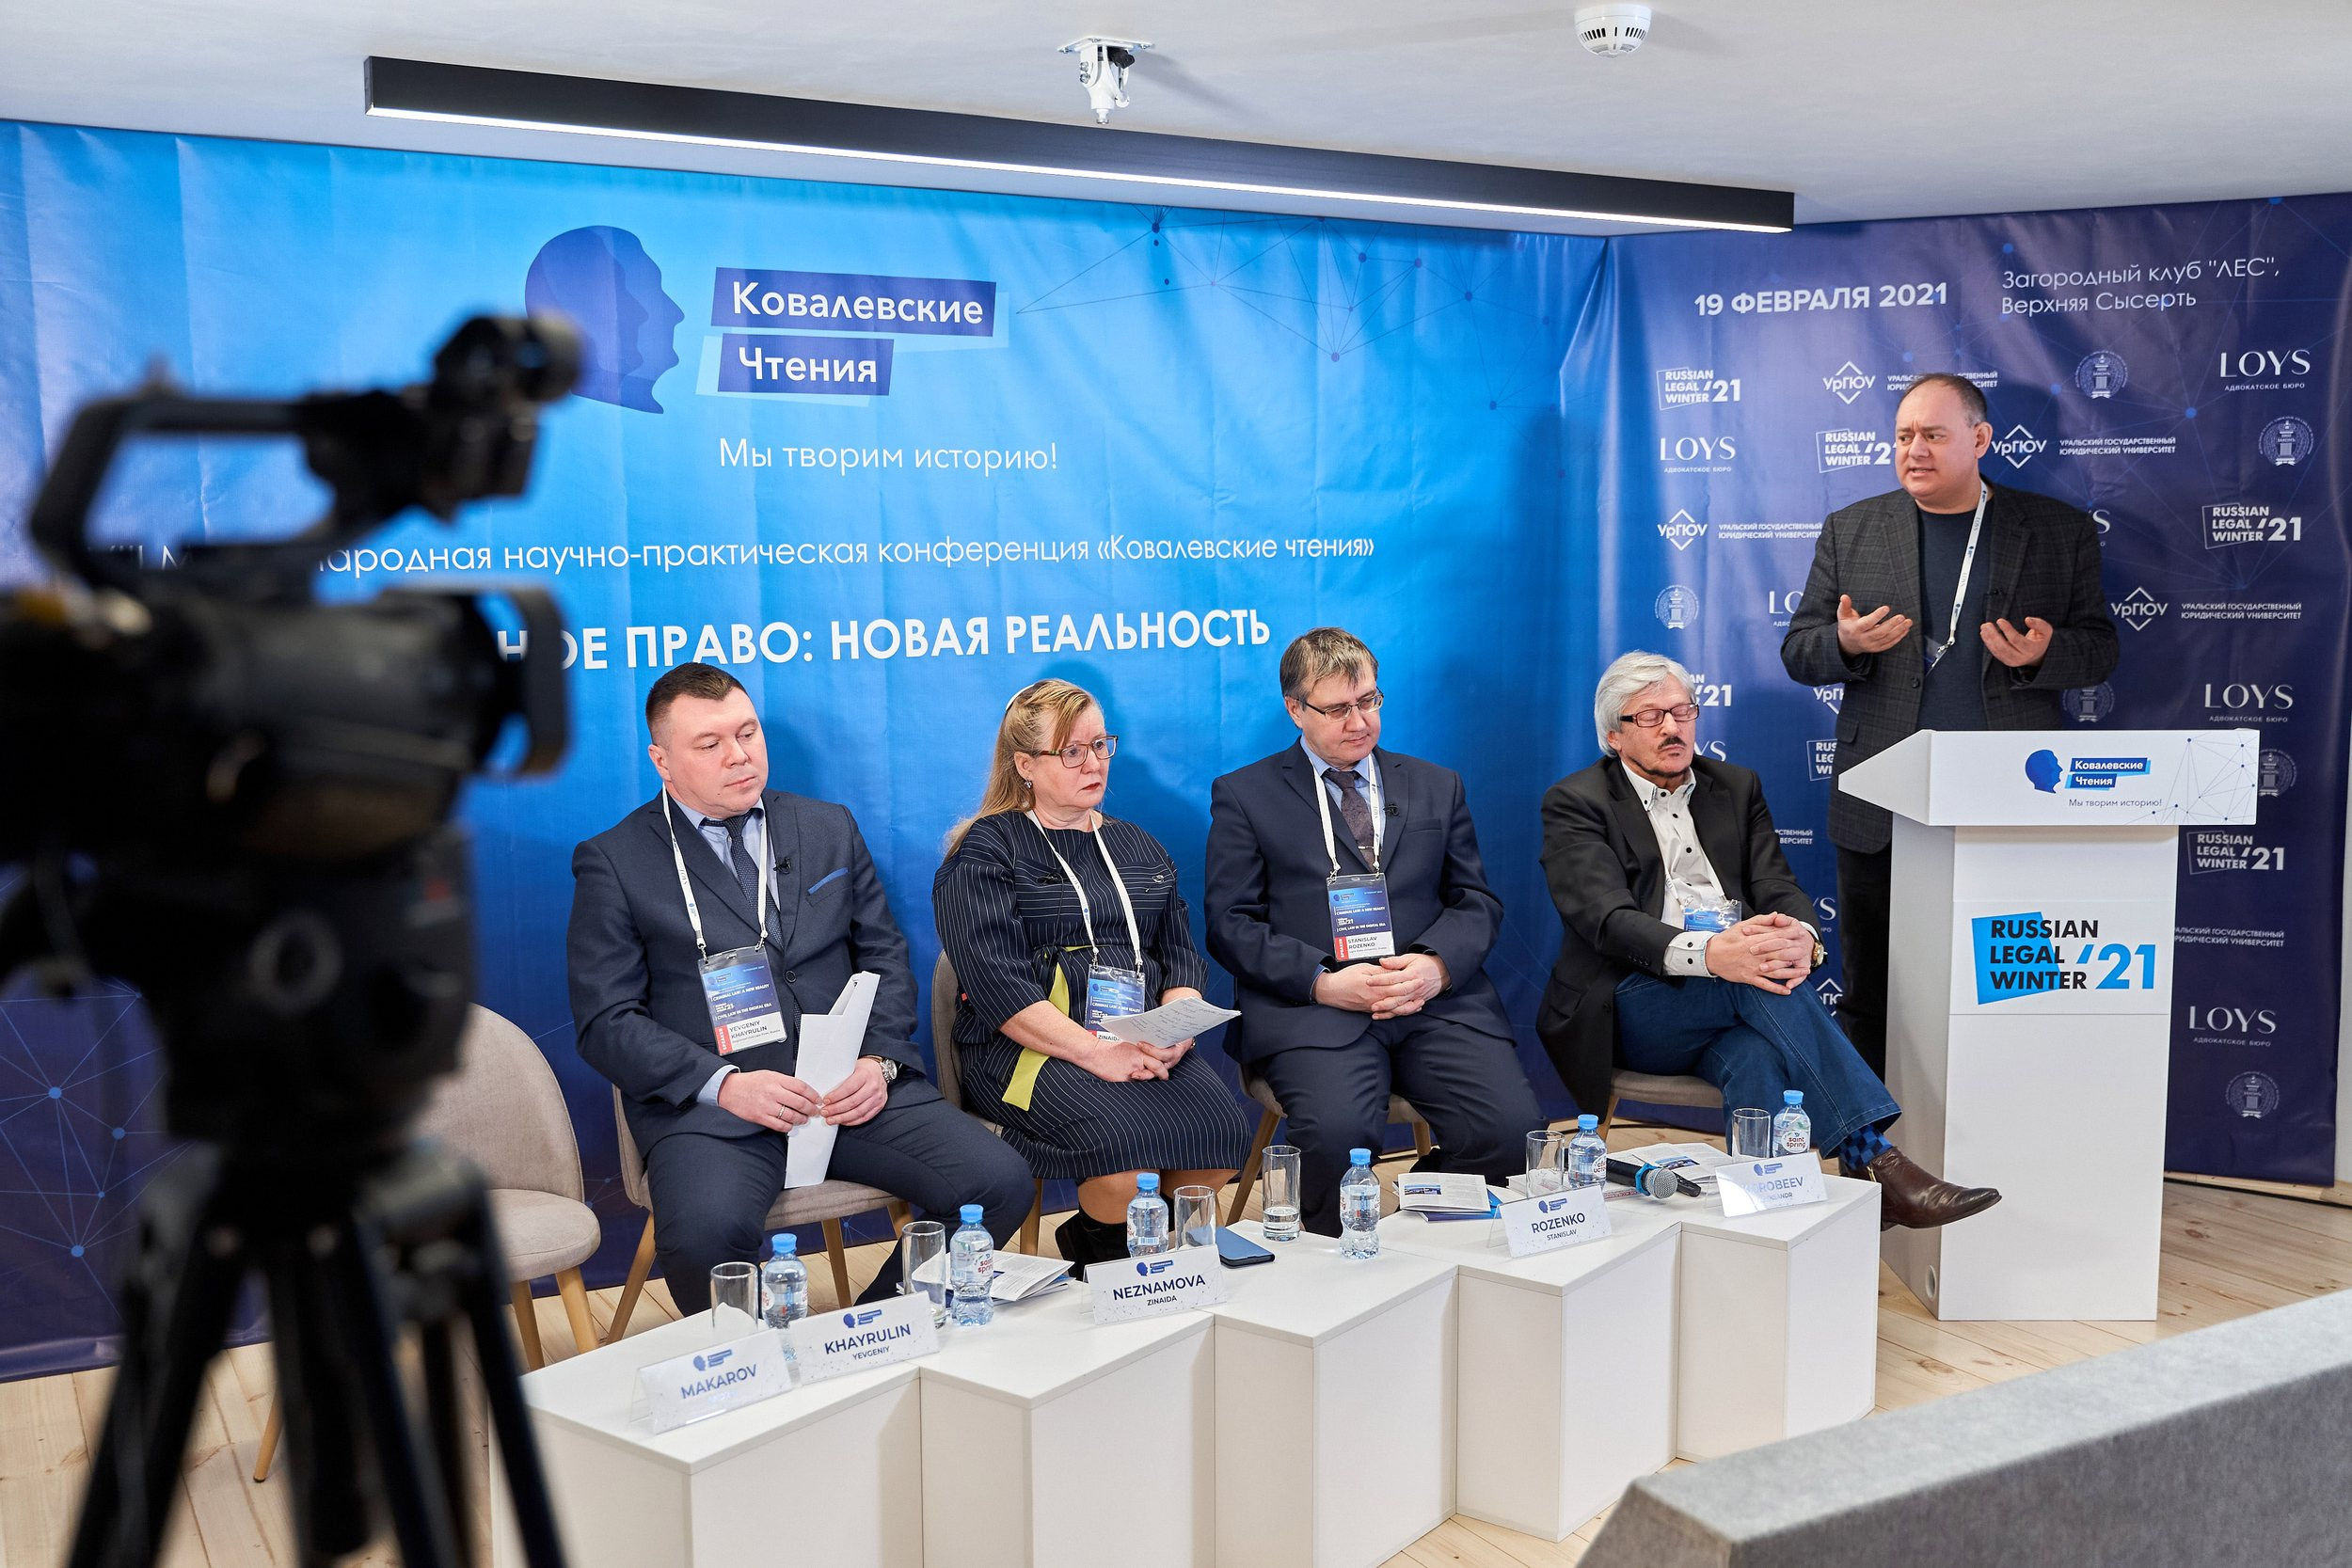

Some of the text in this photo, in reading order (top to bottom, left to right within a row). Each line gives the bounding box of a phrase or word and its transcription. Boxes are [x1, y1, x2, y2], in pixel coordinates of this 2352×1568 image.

[2003, 257, 2280, 291] Загородный клуб "ЛЕС",
[732, 280, 984, 325] Ковалевские
[1694, 282, 1947, 316] 19 ФЕВРАЛЯ 2021
[2002, 293, 2197, 317] Верхняя Сысерть
[739, 346, 877, 383] Чтения
[2220, 349, 2311, 377] LOYS
[1665, 370, 1713, 380] RUSSIAN
[1665, 381, 1699, 391] LEGAL
[1665, 392, 1709, 403] WINTER
[1825, 431, 1875, 443] RUSSIAN
[2059, 436, 2176, 447] УРАЛЬСКИЙ ГОСУДАРСТВЕННЫЙ
[1660, 436, 1736, 462] LOYS
[1825, 443, 1860, 454] LEGAL
[2059, 445, 2175, 455] ЮРИДИЧЕСКИЙ УНИВЕРСИТЕТ
[720, 437, 1057, 477] Мы творим историю!
[1825, 454, 1870, 466] WINTER
[2213, 506, 2269, 516] RUSSIAN
[2213, 519, 2251, 530] LEGAL
[1719, 531, 1772, 539] ЮРИДИЧЕСКИЙ
[2213, 531, 2264, 542] WINTER
[161, 543, 491, 578] Мародная
[503, 537, 868, 576] научно-практическая
[879, 535, 1089, 567] конференция
[1097, 533, 1278, 560] «Ковалевские
[1284, 536, 1375, 558] чтения»
[1769, 591, 1804, 614] LO
[2182, 602, 2301, 610] УРАЛЬСКИЙ ГОСУДАРСТВЕННЫЙ
[2182, 611, 2301, 620] ЮРИДИЧЕСКИЙ УНИВЕРСИТЕТ
[626, 620, 814, 670] ПРАВО:
[832, 615, 990, 660] НОВАЯ
[1006, 609, 1271, 654] РЕАЛЬНОСТЬ
[2204, 684, 2294, 710] LOYS
[2075, 760, 2143, 771] Ковалевские
[2075, 776, 2113, 786] Чтения
[2086, 800, 2118, 809] творим
[2120, 800, 2162, 809] историю!
[2197, 834, 2253, 845] RUSSIAN
[2197, 846, 2235, 857] LEGAL
[2197, 858, 2248, 869] WINTER
[1990, 920, 2099, 939] RUSSIAN
[2212, 928, 2284, 939] ГОСУДАРСТВЕННЫЙ
[2231, 939, 2284, 947] УНИВЕРСИТЕТ
[1990, 945, 2064, 964] LEGAL
[1990, 972, 2087, 990] WINTER
[2189, 1006, 2277, 1034] LOYS
[729, 1021, 760, 1032] YEVGENIY
[731, 1025, 767, 1039] KHAYRULIN
[2193, 1037, 2246, 1046] АДВОКАТСКОЕ
[1532, 1212, 1585, 1233] ROZENKO
[1547, 1229, 1577, 1241] STANISLAV
[1113, 1275, 1205, 1300] NEZNAMOVA
[1147, 1295, 1177, 1306] ZINAIDA
[825, 1323, 911, 1354] KHAYRULIN
[852, 1346, 890, 1360] YEVGENIY
[680, 1364, 756, 1399] MAKAROV
